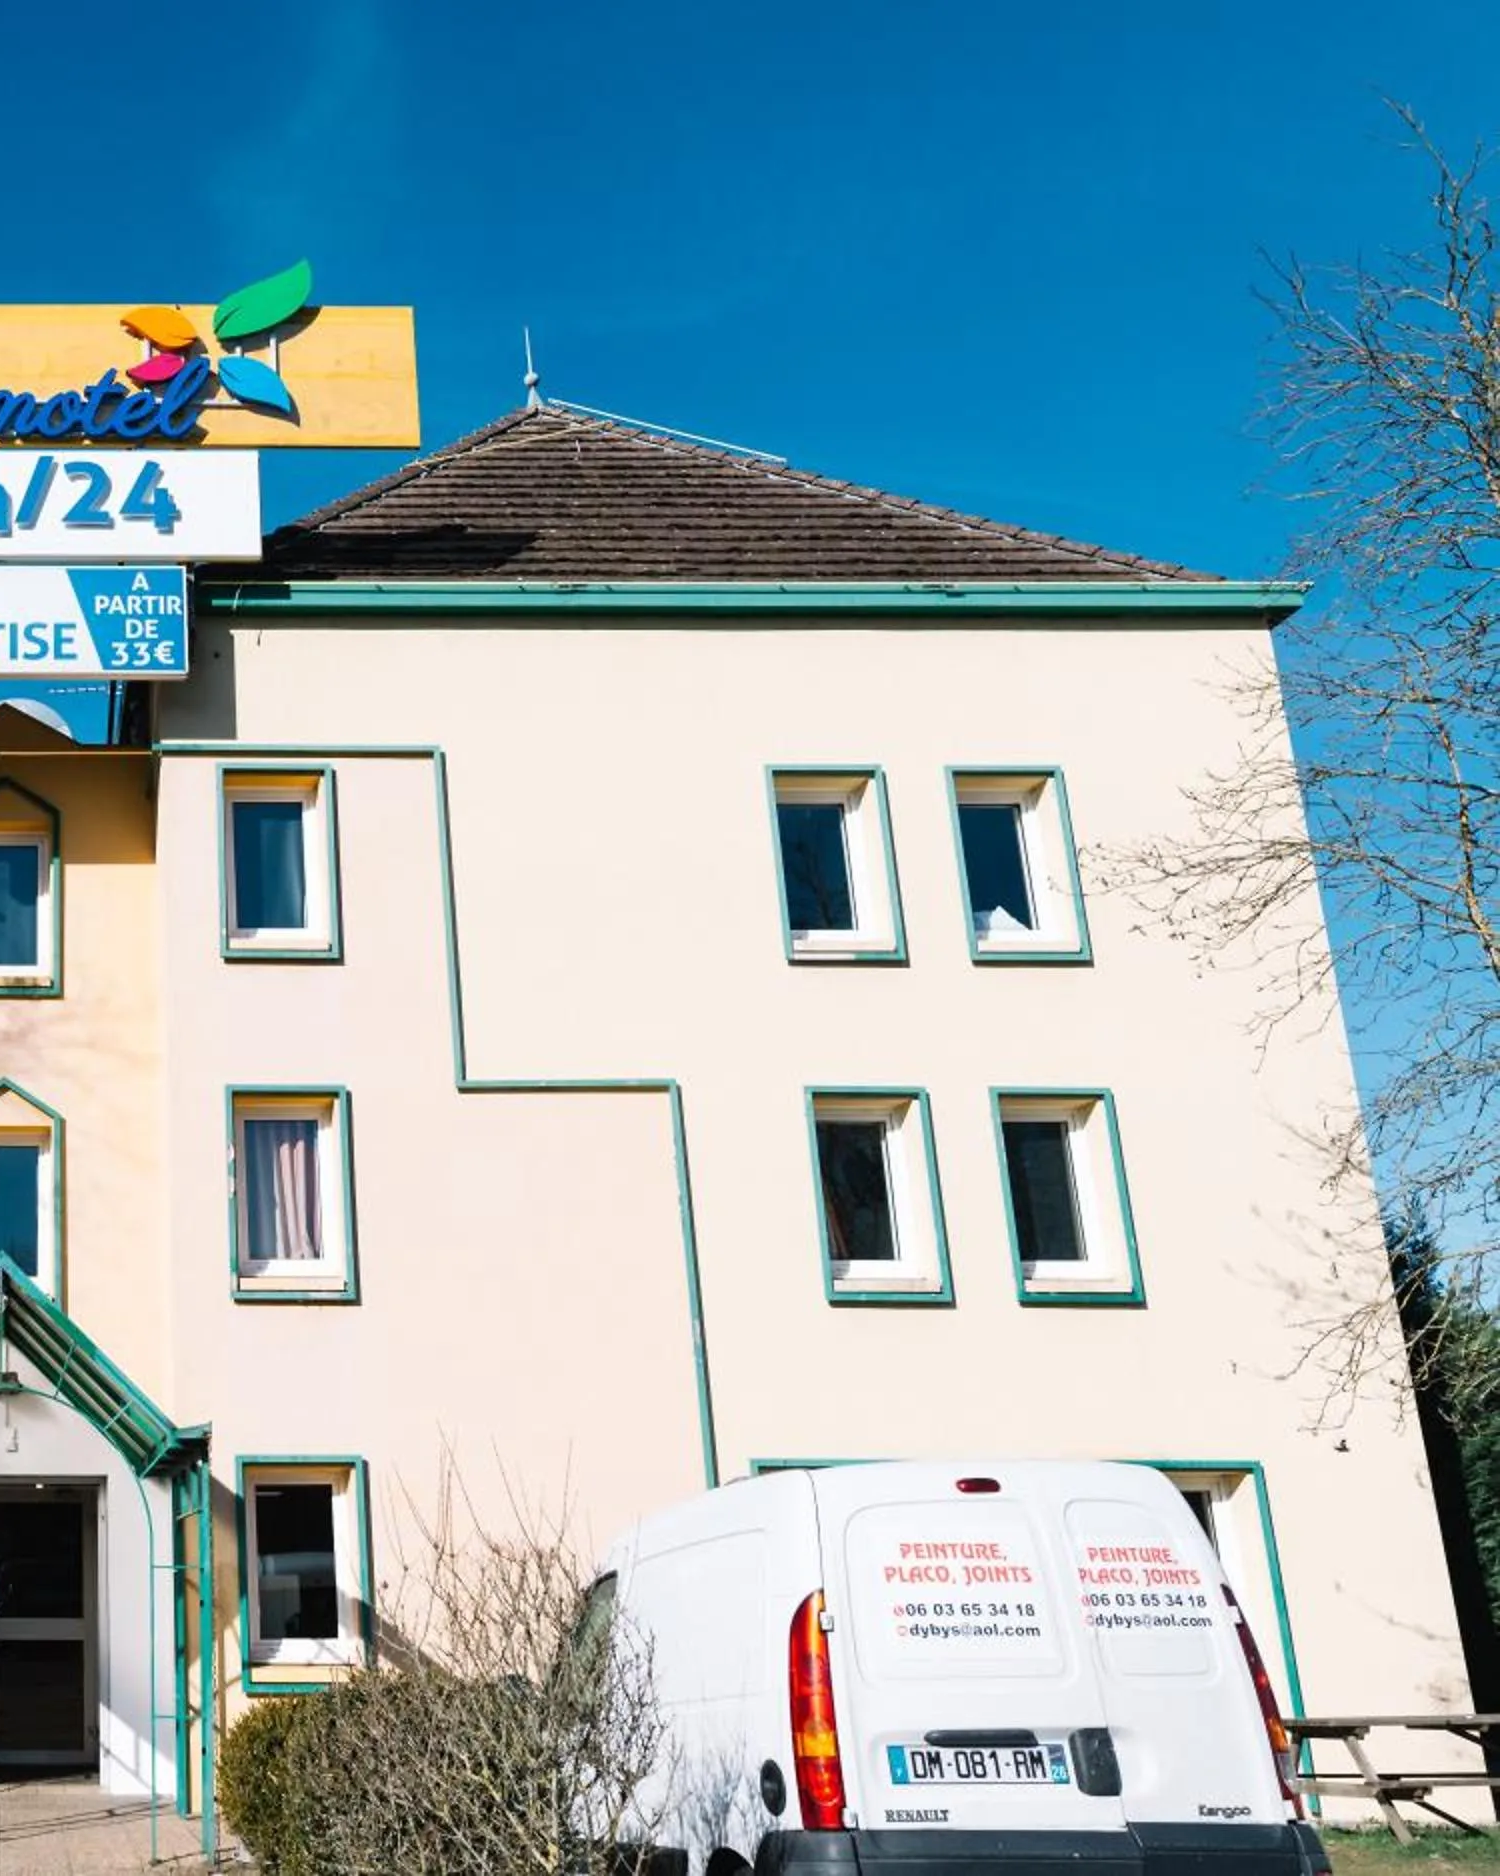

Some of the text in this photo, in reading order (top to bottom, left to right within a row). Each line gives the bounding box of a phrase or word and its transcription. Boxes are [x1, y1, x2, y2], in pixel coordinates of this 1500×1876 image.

[131, 572, 148, 591] A
[94, 595, 183, 615] PARTIR
[125, 620, 159, 639] DE
[110, 640, 176, 666] 33€
[899, 1543, 1008, 1561] PEINTURE,
[883, 1566, 1033, 1586] PLACO, JOINTS
[1142, 1569, 1201, 1587] JOINTS
[1090, 1593, 1208, 1608] 06 03 65 34 18
[905, 1603, 1036, 1617] 06 03 65 34 18
[909, 1623, 1041, 1639] dybys@aol.com
[885, 1809, 949, 1823] RENAULT
[1199, 1804, 1252, 1819] Kangoo
